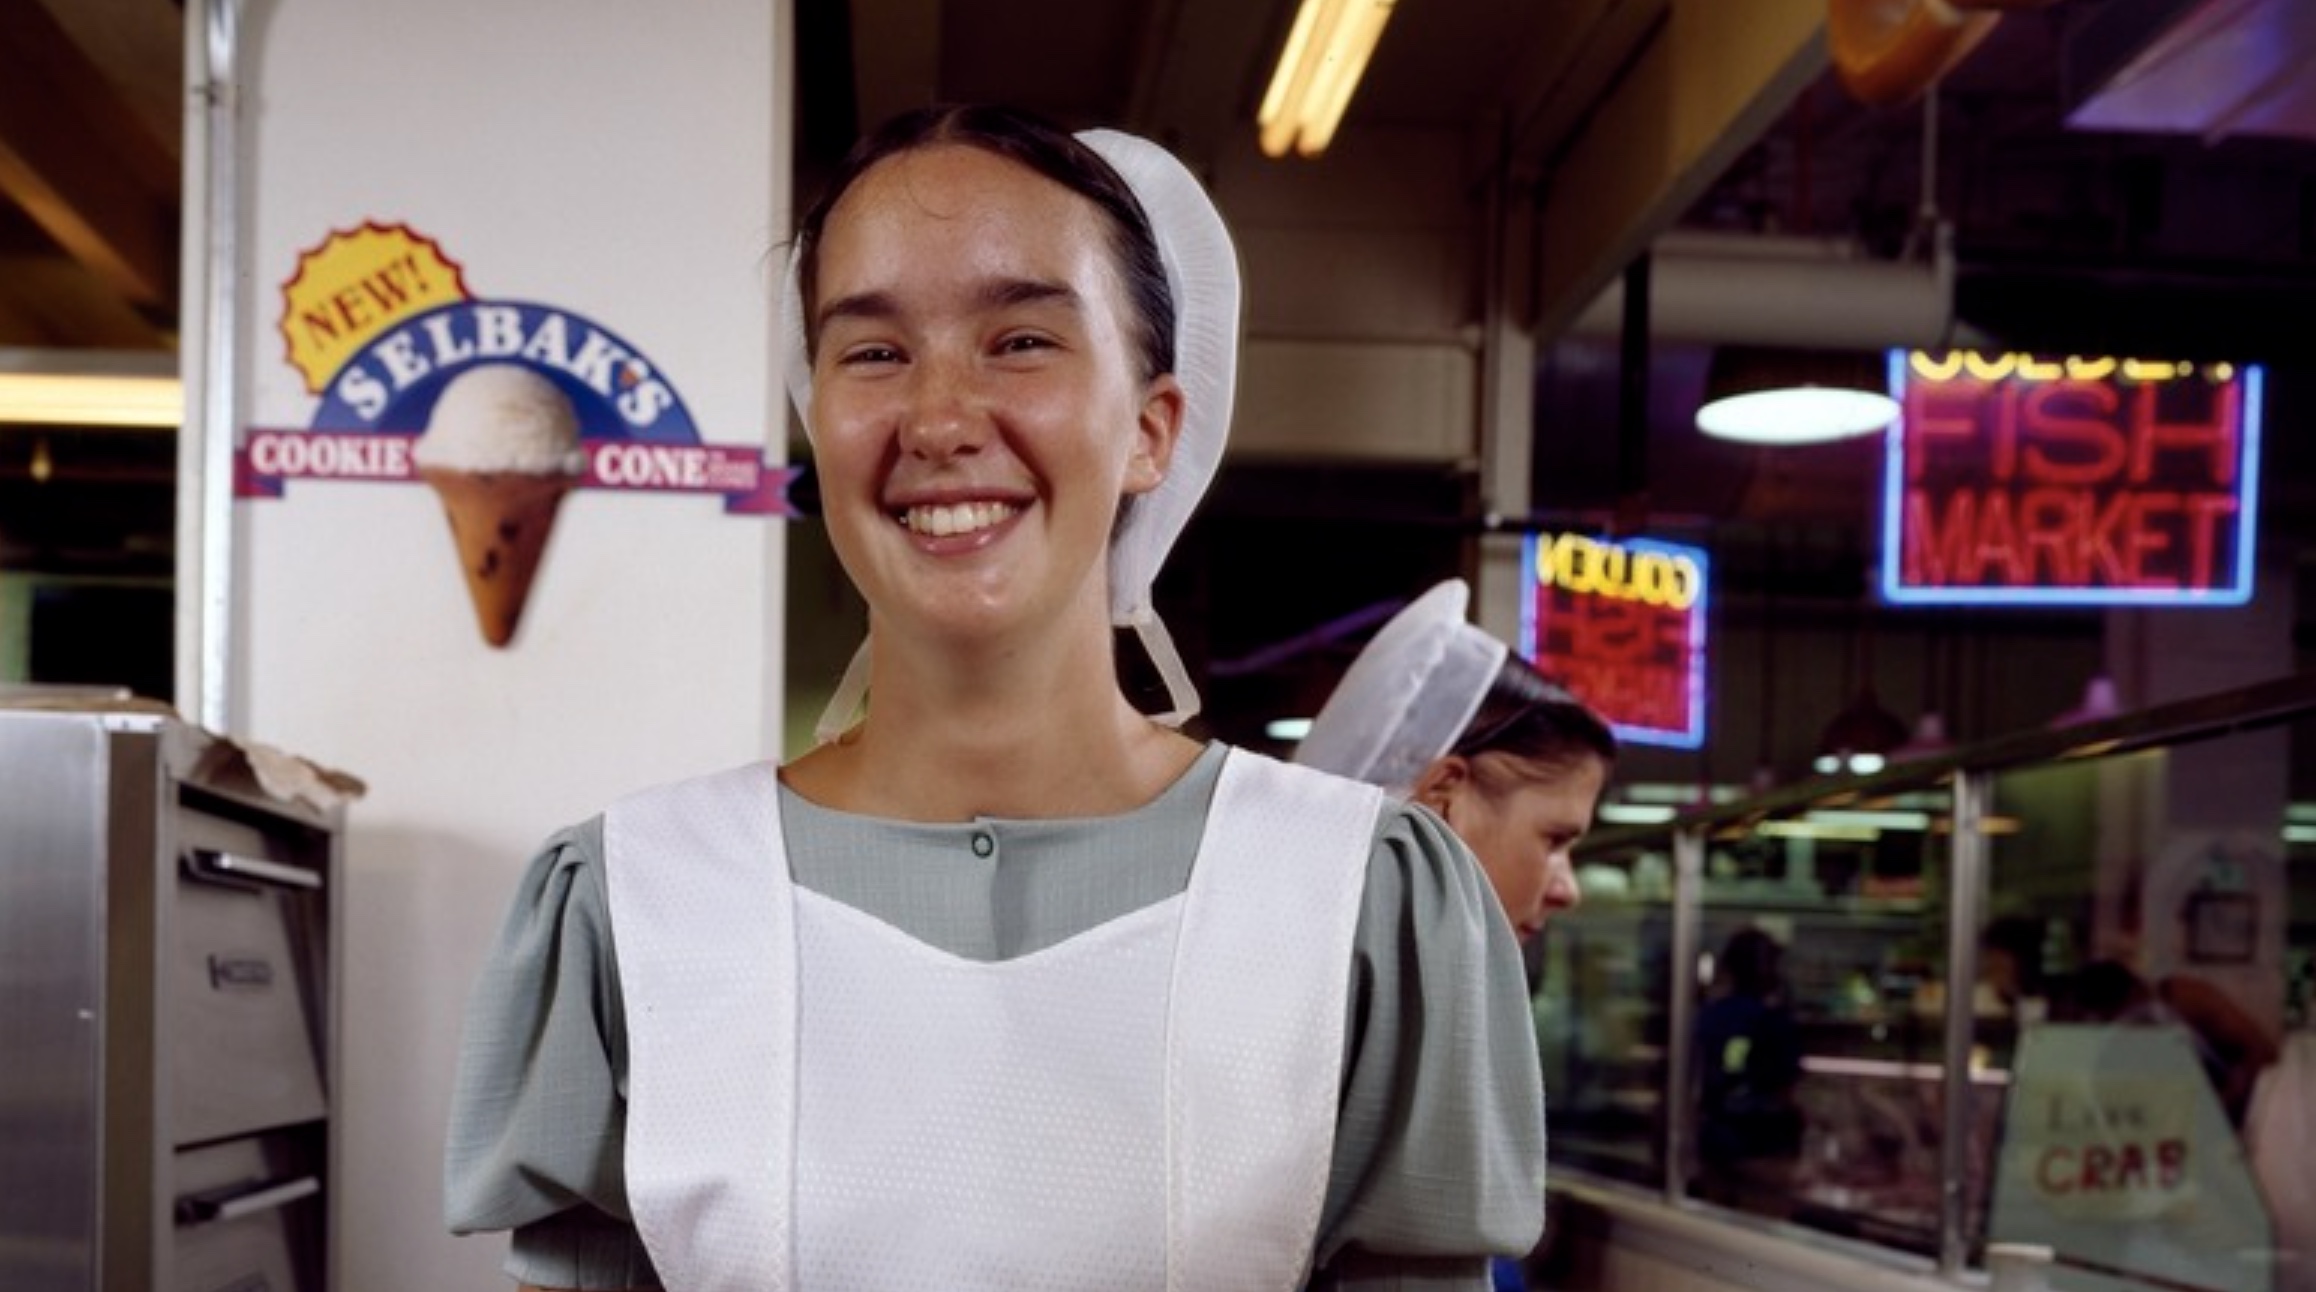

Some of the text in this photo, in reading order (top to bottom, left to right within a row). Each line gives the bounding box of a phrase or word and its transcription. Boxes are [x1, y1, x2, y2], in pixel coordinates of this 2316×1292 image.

[302, 252, 430, 352] NEW!
[337, 304, 673, 428] SELBAK'S
[251, 434, 409, 477] COOKIE
[596, 446, 709, 488] CONE
[1905, 379, 2239, 485] FISH
[1904, 486, 2239, 597] MARKET
[2035, 1137, 2187, 1196] CRAB
